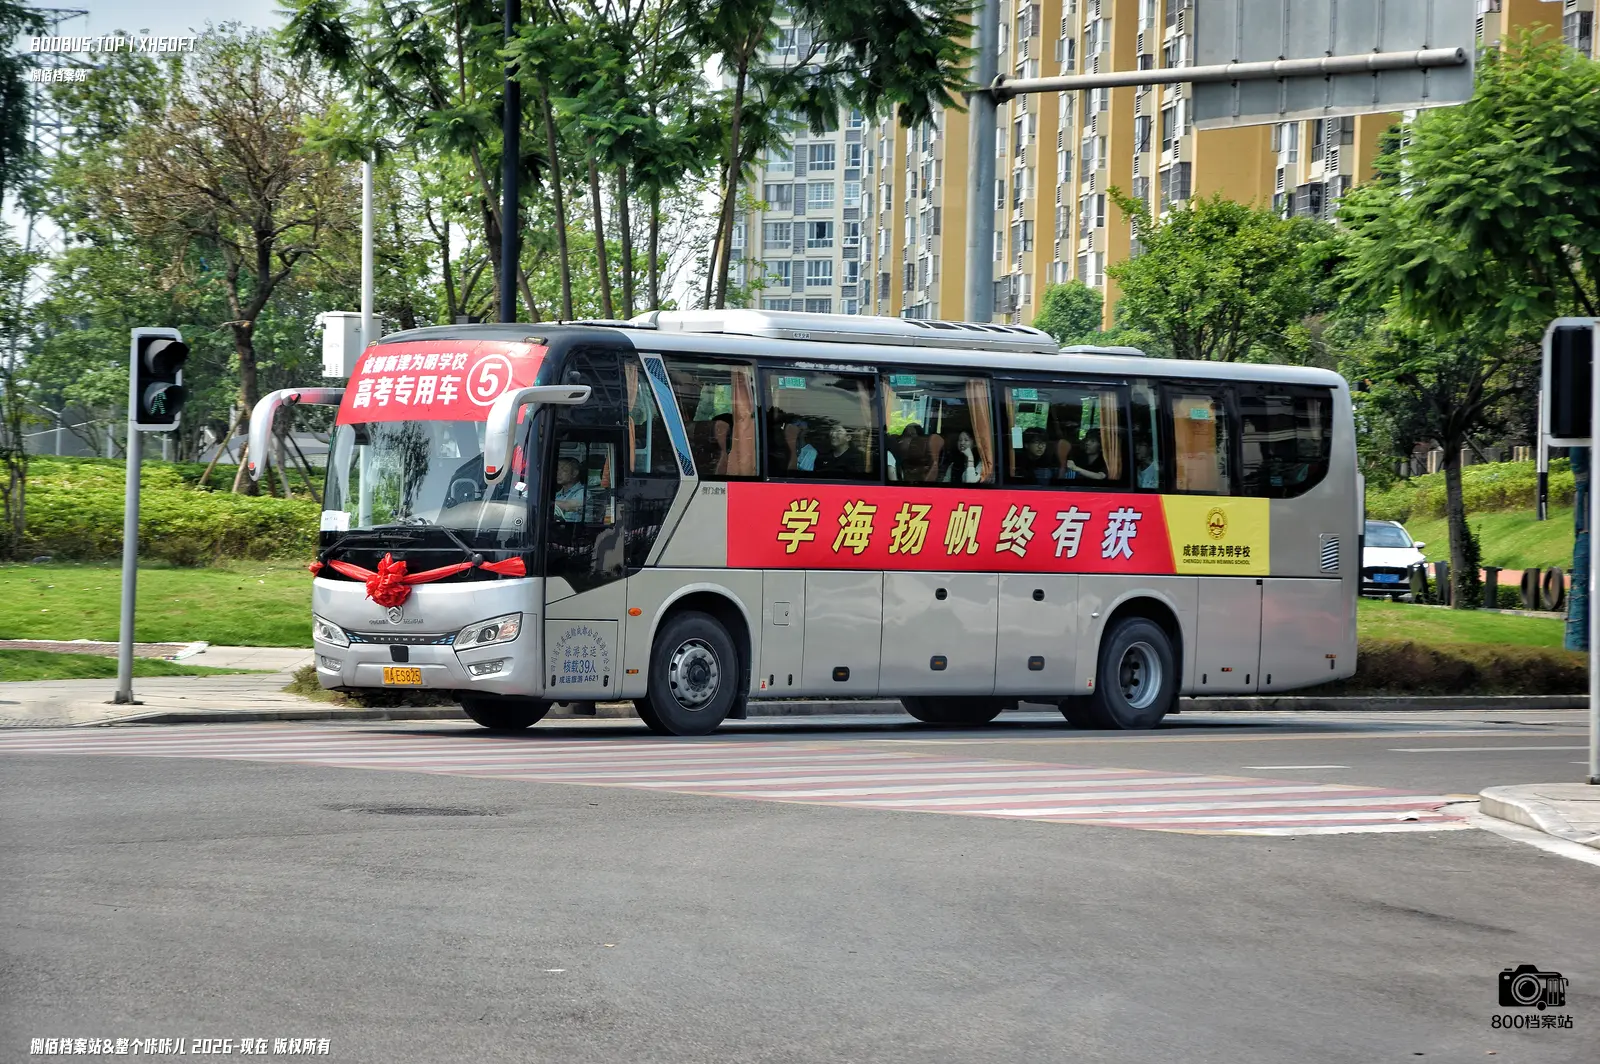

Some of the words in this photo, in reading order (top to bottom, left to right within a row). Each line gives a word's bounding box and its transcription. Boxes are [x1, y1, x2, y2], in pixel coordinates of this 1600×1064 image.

[361, 352, 468, 375] 成都新津为明学校
[353, 374, 461, 409] 高考专用车
[777, 499, 1142, 560] 学海扬帆终有获
[1183, 544, 1251, 558] 成都新津为明学校
[563, 660, 597, 674] 核载39人
[584, 674, 599, 682] A621
